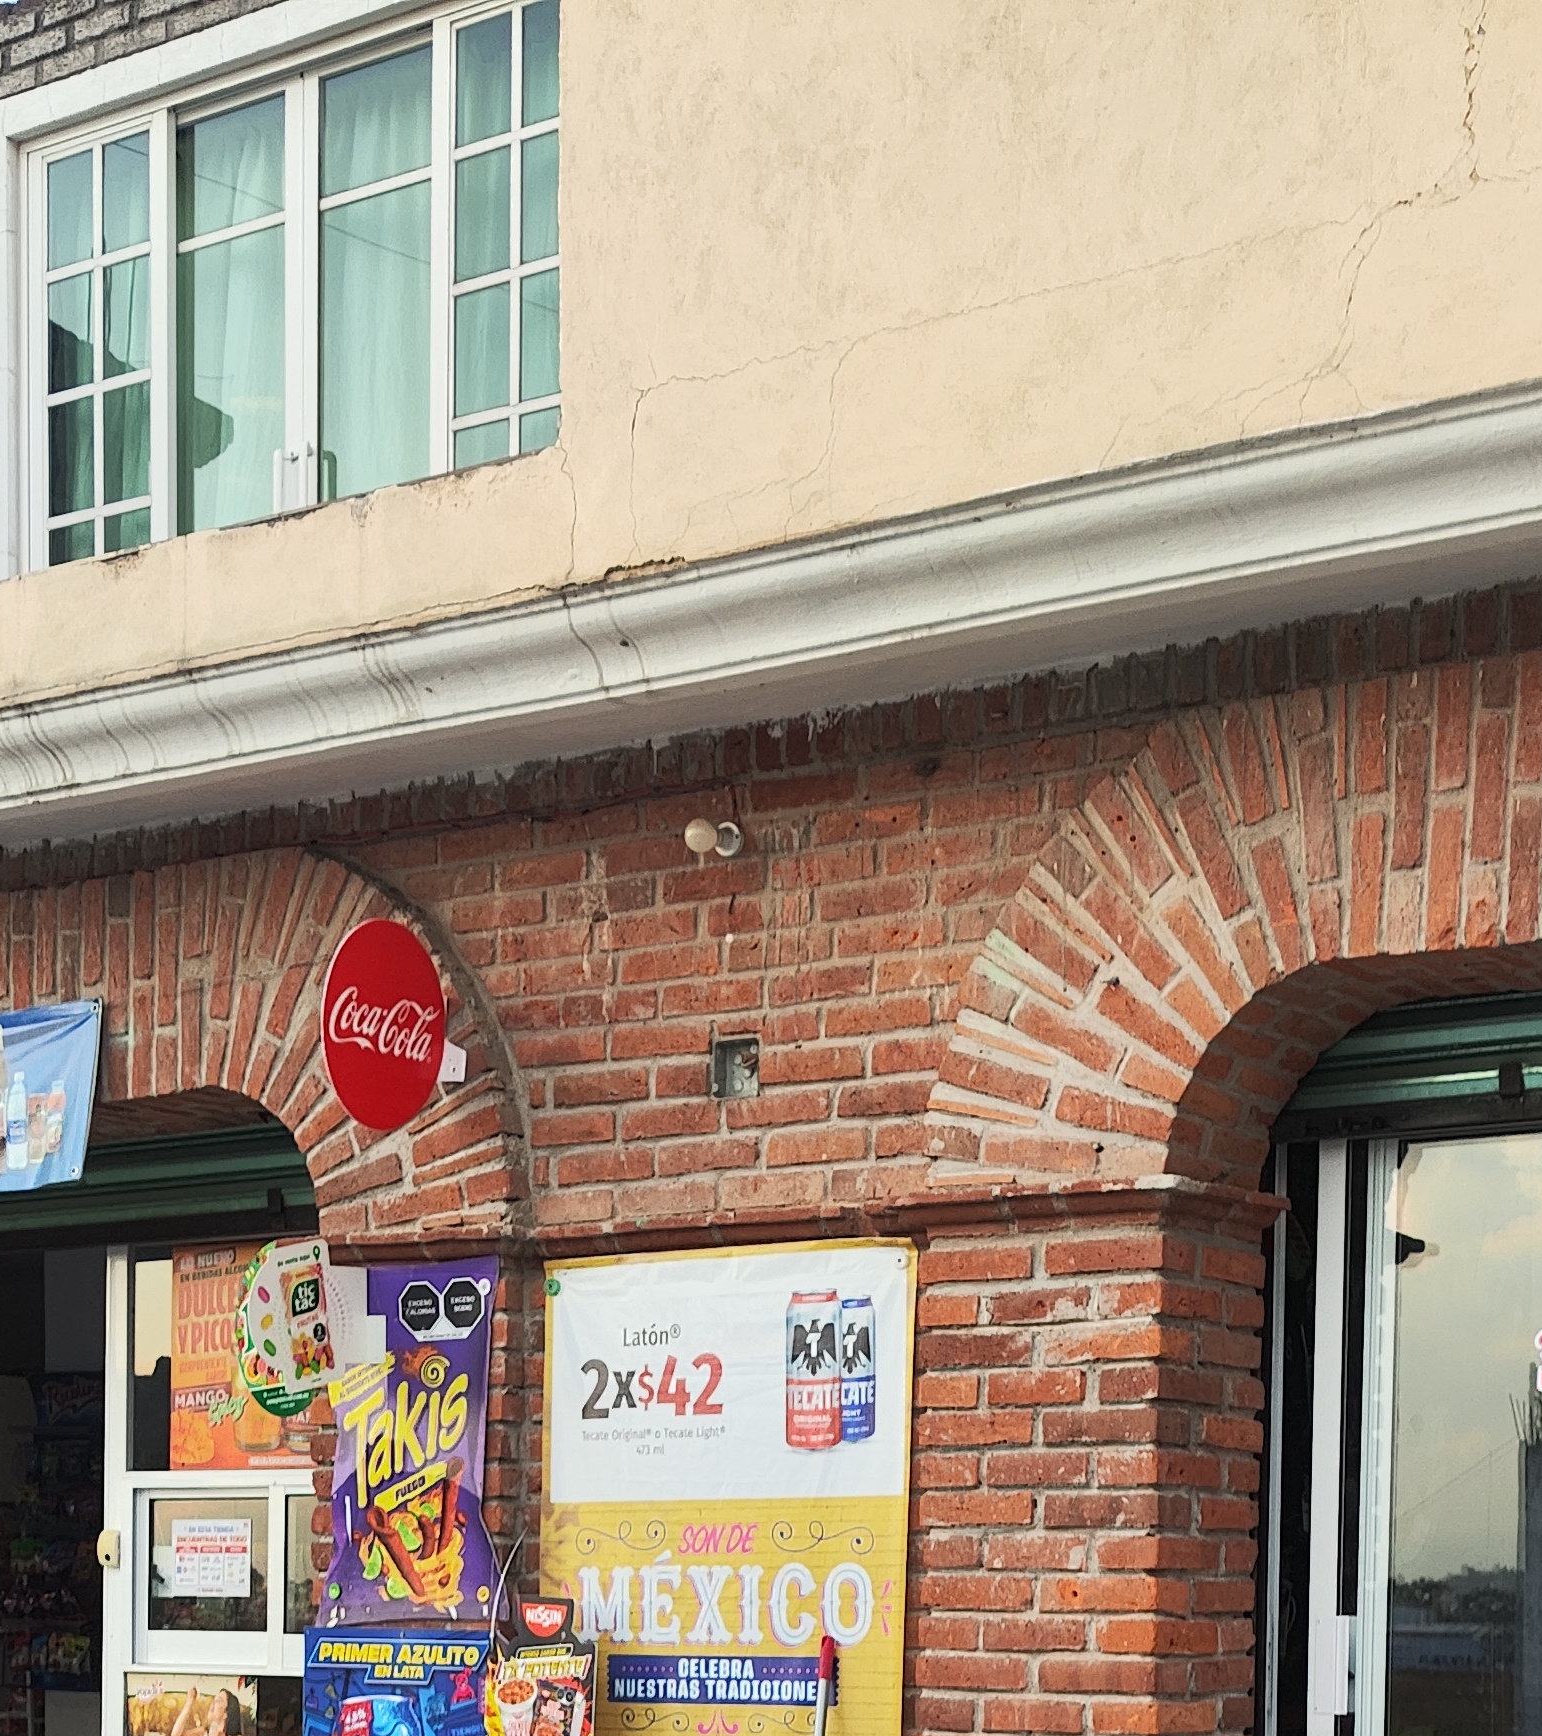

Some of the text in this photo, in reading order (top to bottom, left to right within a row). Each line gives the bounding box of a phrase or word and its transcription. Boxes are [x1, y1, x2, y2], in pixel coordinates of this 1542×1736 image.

[297, 1281, 316, 1296] tic
[294, 1295, 317, 1312] tac
[580, 1352, 724, 1420] 2x$42
[787, 1382, 840, 1411] TECATE
[841, 1379, 876, 1406] CATE
[175, 1388, 227, 1409] MANGO
[581, 1429, 609, 1441] Tecate
[654, 1430, 662, 1439] o
[663, 1426, 694, 1439] Tecate
[677, 1522, 759, 1555] SON DE
[575, 1549, 876, 1649] MÉXICO
[525, 1606, 563, 1628] NISSIN
[318, 1642, 480, 1667] PRIMER AZULITO
[374, 1665, 424, 1680] EN LATA
[678, 1657, 755, 1680] CELEBRA
[614, 1677, 818, 1702] NUESTRAS TRADICIONE
